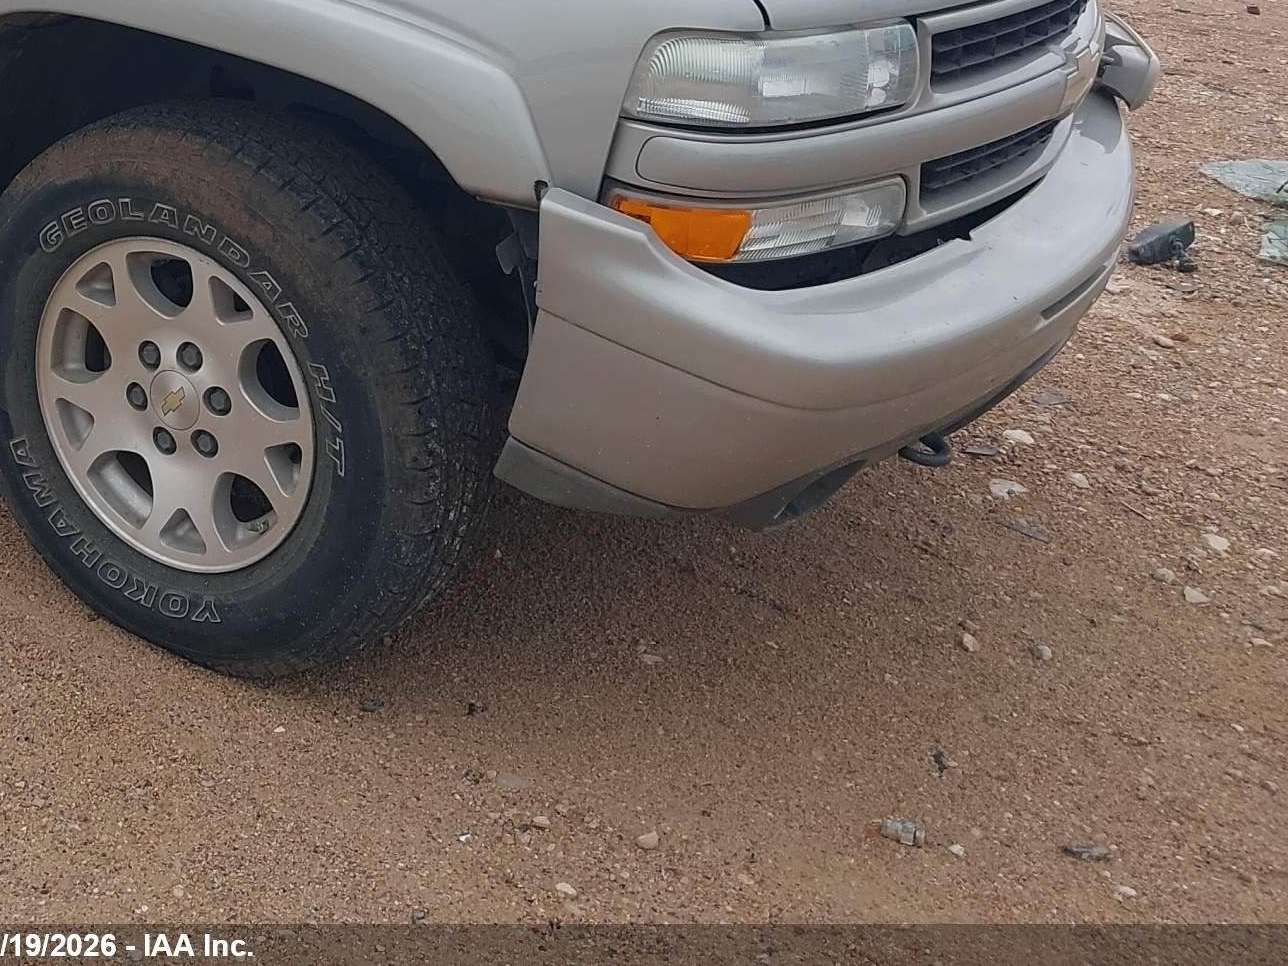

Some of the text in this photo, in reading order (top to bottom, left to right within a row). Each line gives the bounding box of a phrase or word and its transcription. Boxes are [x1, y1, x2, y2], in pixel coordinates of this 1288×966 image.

[38, 197, 346, 477] GEOLANDAR H/T
[9, 438, 222, 624] YOKOHAMA
